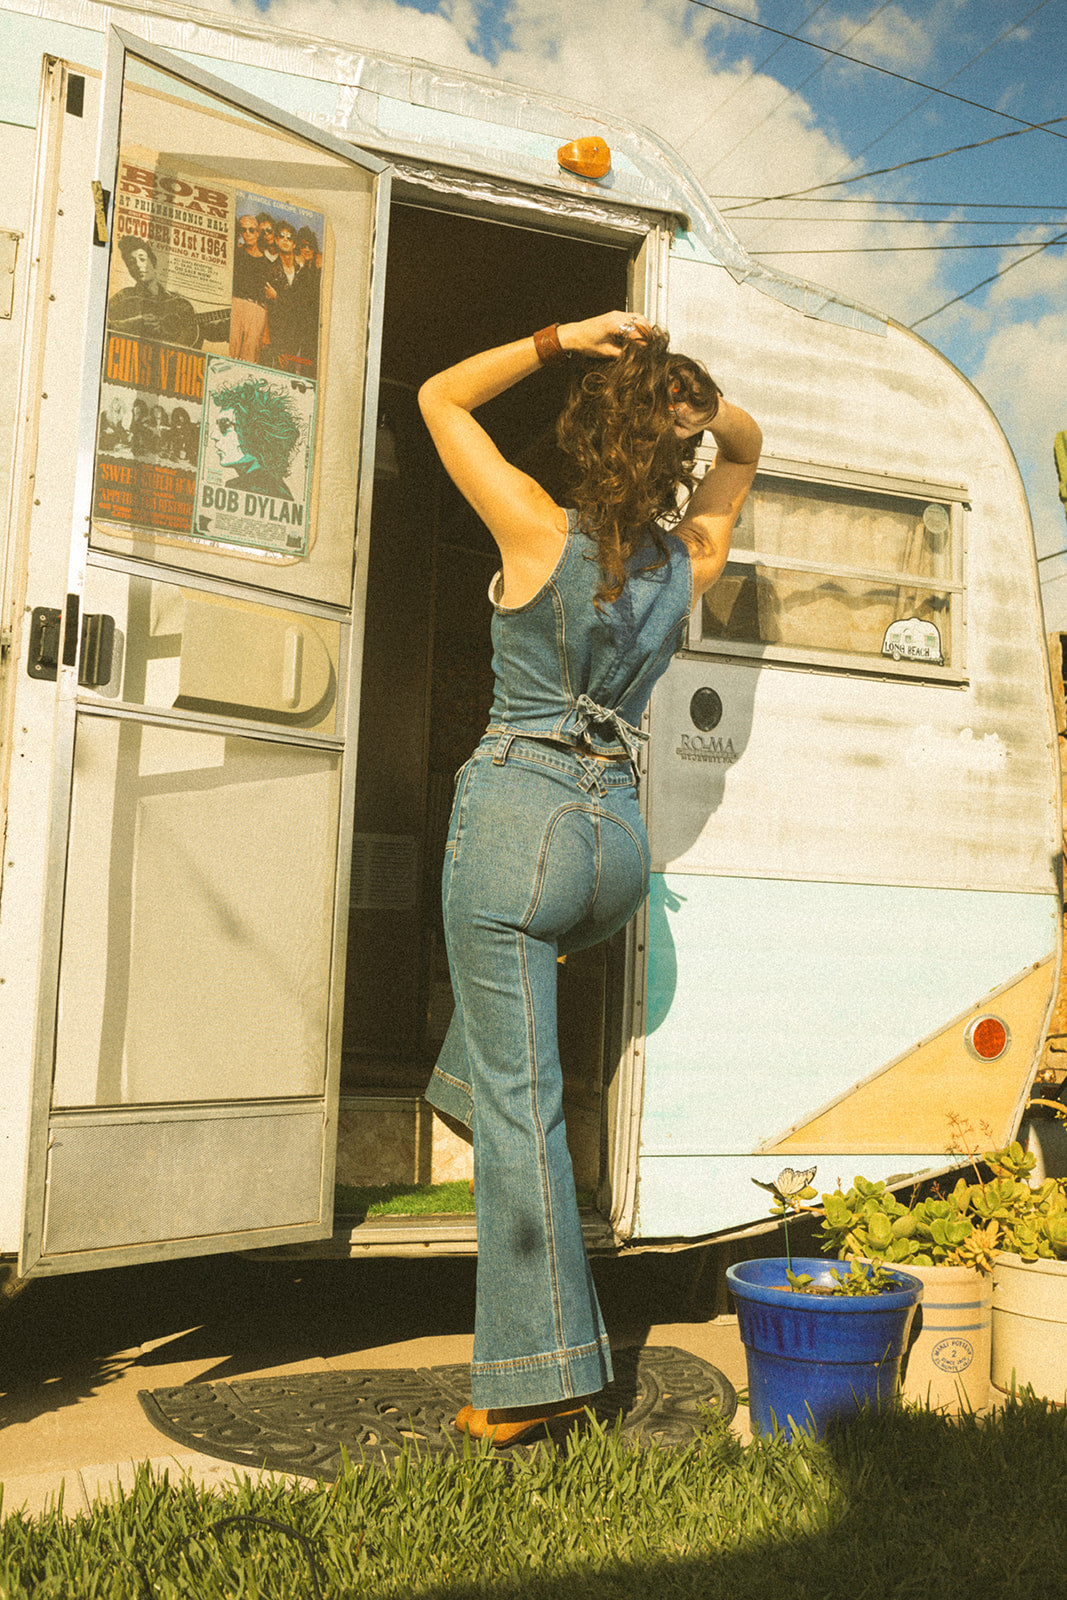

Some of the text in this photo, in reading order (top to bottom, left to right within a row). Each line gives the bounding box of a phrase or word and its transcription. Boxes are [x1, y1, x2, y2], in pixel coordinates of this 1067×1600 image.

[120, 181, 229, 219] DYLAN
[122, 164, 228, 208] BOB
[119, 195, 131, 207] AT
[134, 198, 203, 226] PHILHARMONIC
[207, 220, 229, 233] HALL
[118, 215, 170, 244] OCTOBER
[173, 228, 197, 251] 31st
[200, 236, 227, 259] 1964
[156, 241, 189, 256] EVENING
[107, 336, 152, 387] GUNS
[201, 484, 303, 526] BOB DYLAN
[884, 641, 930, 657] LONG BEACH
[951, 1349, 957, 1358] 2
